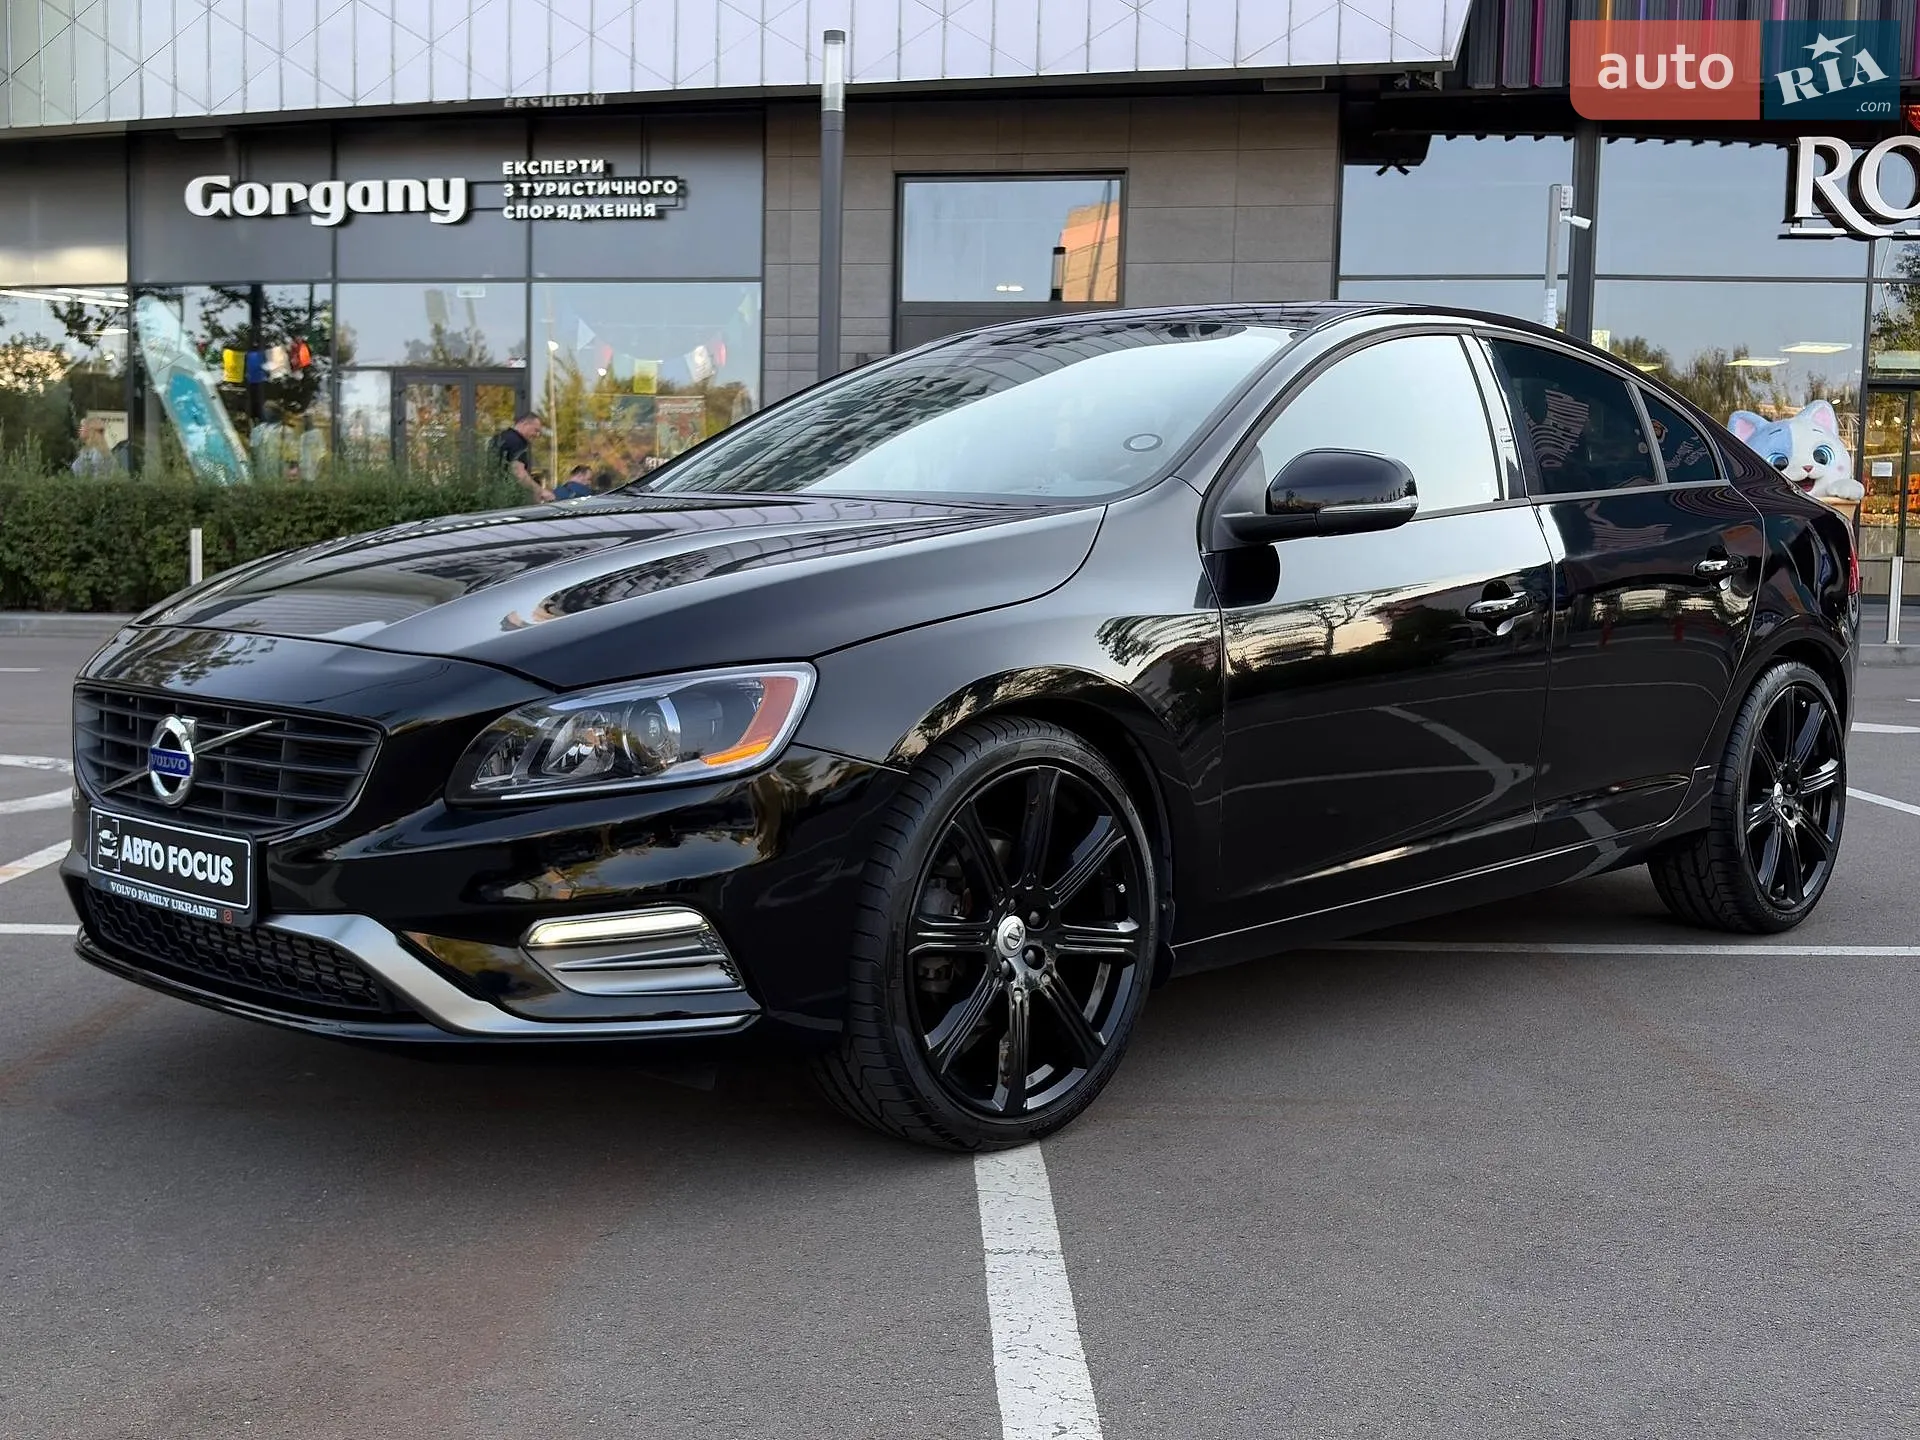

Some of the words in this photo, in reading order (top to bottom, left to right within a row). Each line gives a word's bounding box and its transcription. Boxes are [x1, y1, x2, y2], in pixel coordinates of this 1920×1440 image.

[502, 159, 604, 175] ЕКСПЕРТИ
[503, 184, 514, 197] З
[520, 180, 678, 197] ТУРИСТИЧНОГО
[1794, 135, 1920, 237] RO
[184, 175, 467, 226] Gorgany
[502, 204, 656, 220] СПОРЯДЖЕННЯ
[151, 754, 188, 770] VOLVO
[168, 845, 234, 887] FOCUS
[110, 881, 137, 898] VOLVO
[138, 890, 170, 907] FAMILY
[171, 899, 218, 919] UKRAINE
